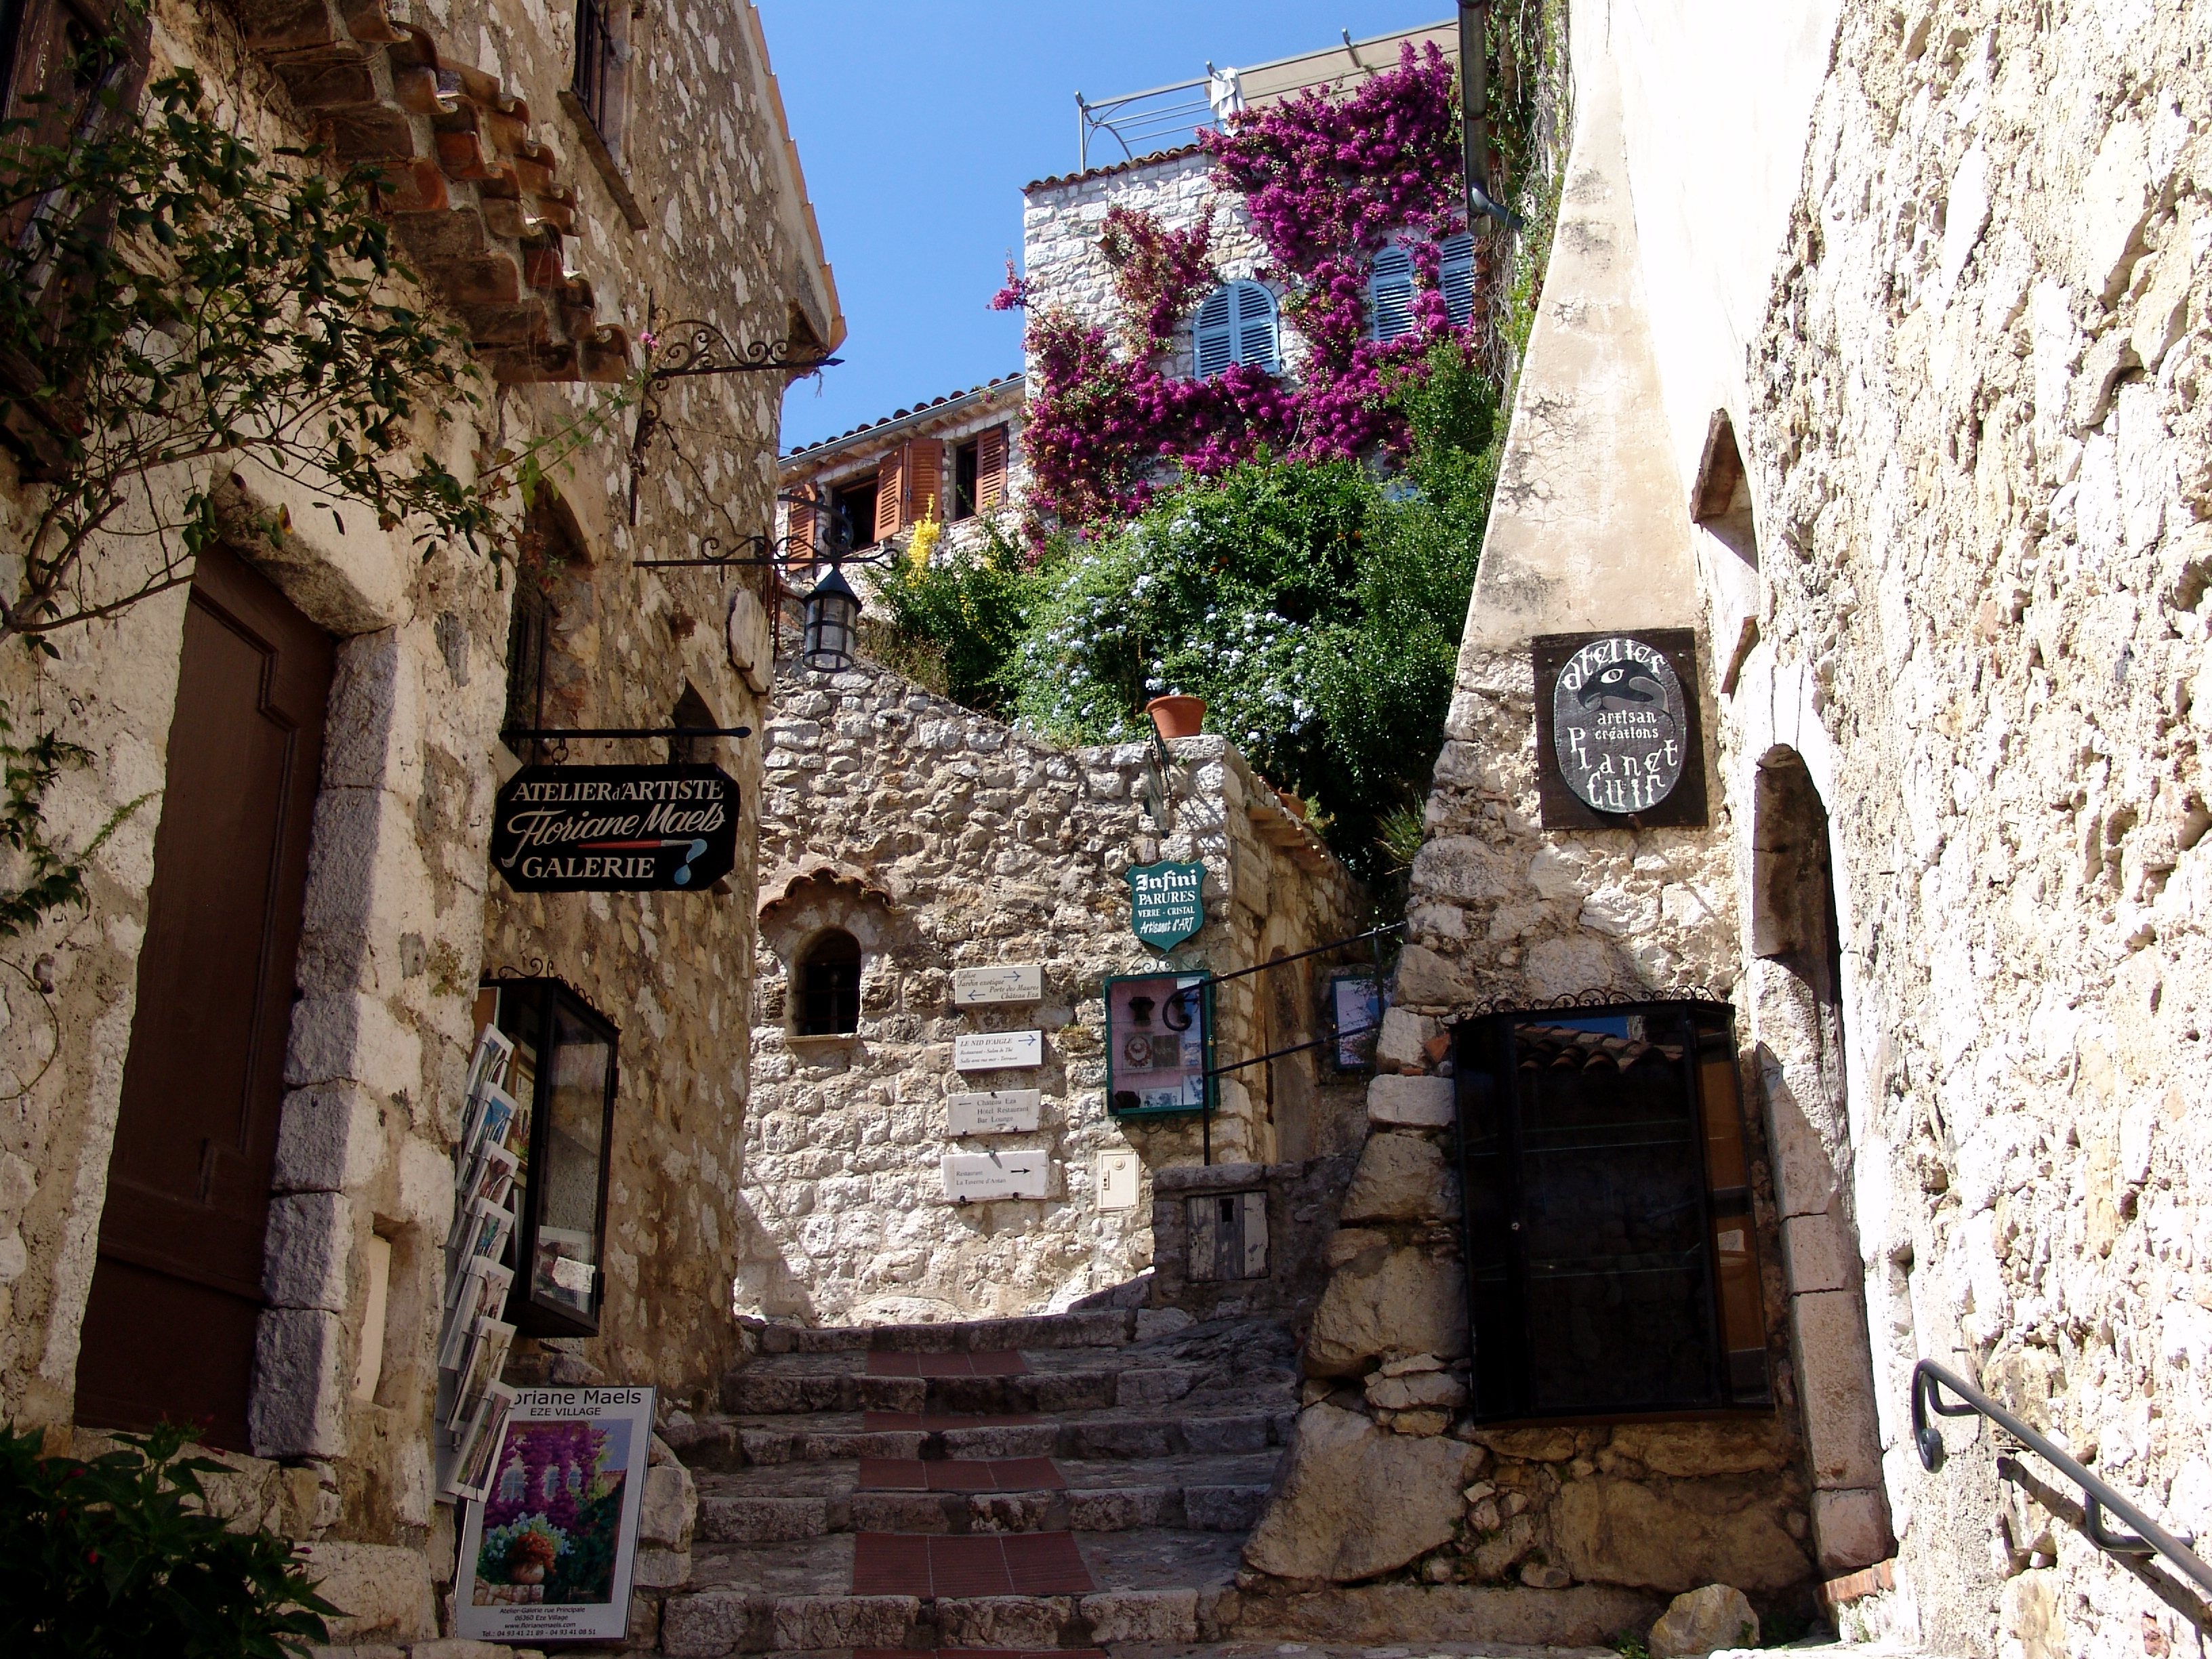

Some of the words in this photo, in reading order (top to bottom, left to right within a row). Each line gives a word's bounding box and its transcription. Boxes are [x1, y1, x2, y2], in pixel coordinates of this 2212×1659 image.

[1597, 710, 1657, 724] artisan
[1567, 726, 1678, 774] Planet
[510, 782, 612, 802] ATELIER
[612, 779, 724, 801] d'ARTISTE
[501, 806, 640, 867] Floriane
[636, 802, 726, 838] Maels
[522, 857, 655, 878] GALERIE
[1136, 869, 1197, 892] Infini
[1139, 890, 1195, 905] PARURES
[1138, 909, 1161, 918] VERRE
[1167, 906, 1195, 916] CRISTAL
[1172, 917, 1194, 933] d'ART
[514, 1390, 575, 1405] oriane
[583, 1389, 641, 1404] Maels
[530, 1408, 551, 1416] EZE
[555, 1407, 601, 1416] VILLAGE
